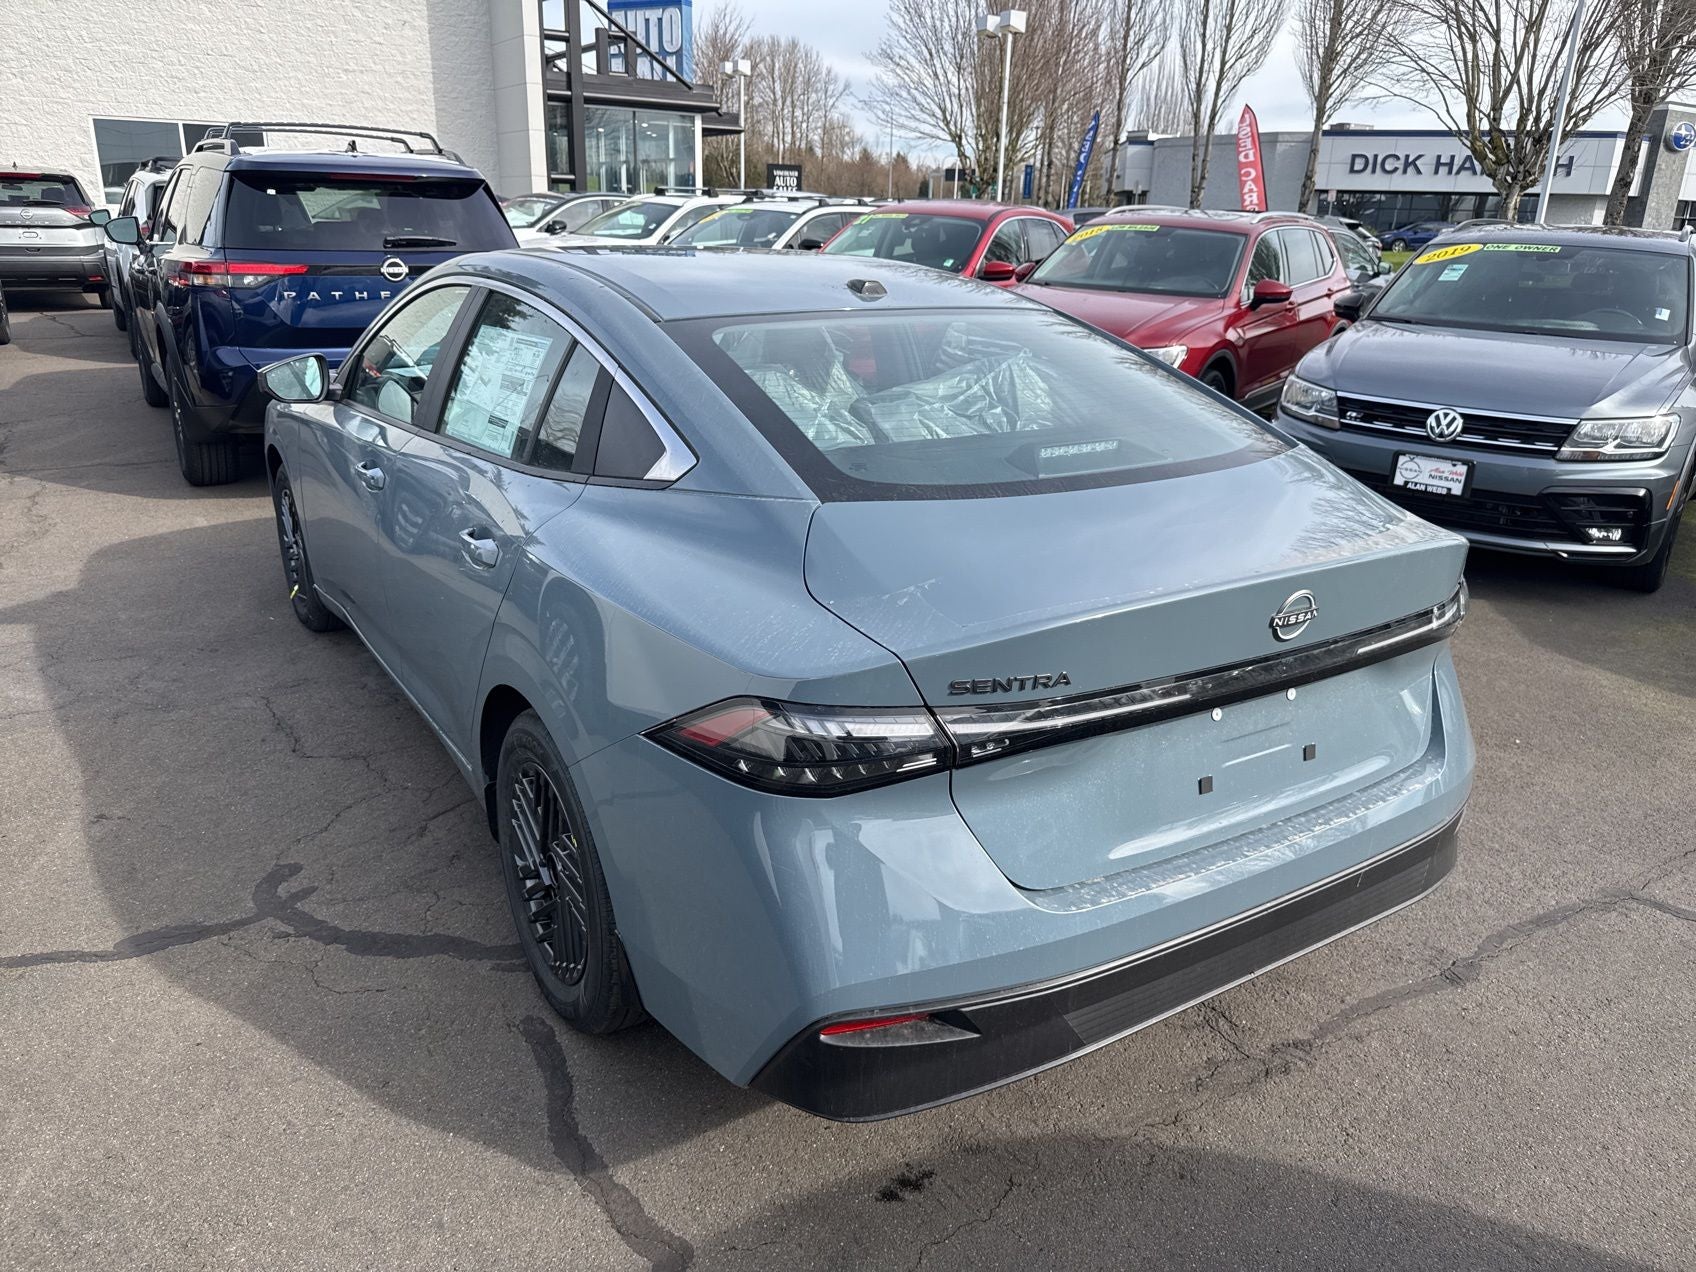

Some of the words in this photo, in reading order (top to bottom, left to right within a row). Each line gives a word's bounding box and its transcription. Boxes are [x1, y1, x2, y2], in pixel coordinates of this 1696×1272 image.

[1349, 153, 1425, 176] DICK
[1433, 153, 1575, 177] HAH
[774, 176, 797, 187] AUTO
[1426, 245, 1472, 262] 2019
[1406, 482, 1426, 492] ALAN
[1428, 473, 1463, 484] NISSAN
[1273, 609, 1318, 627] NISSAN
[947, 671, 1071, 696] SENTRA
